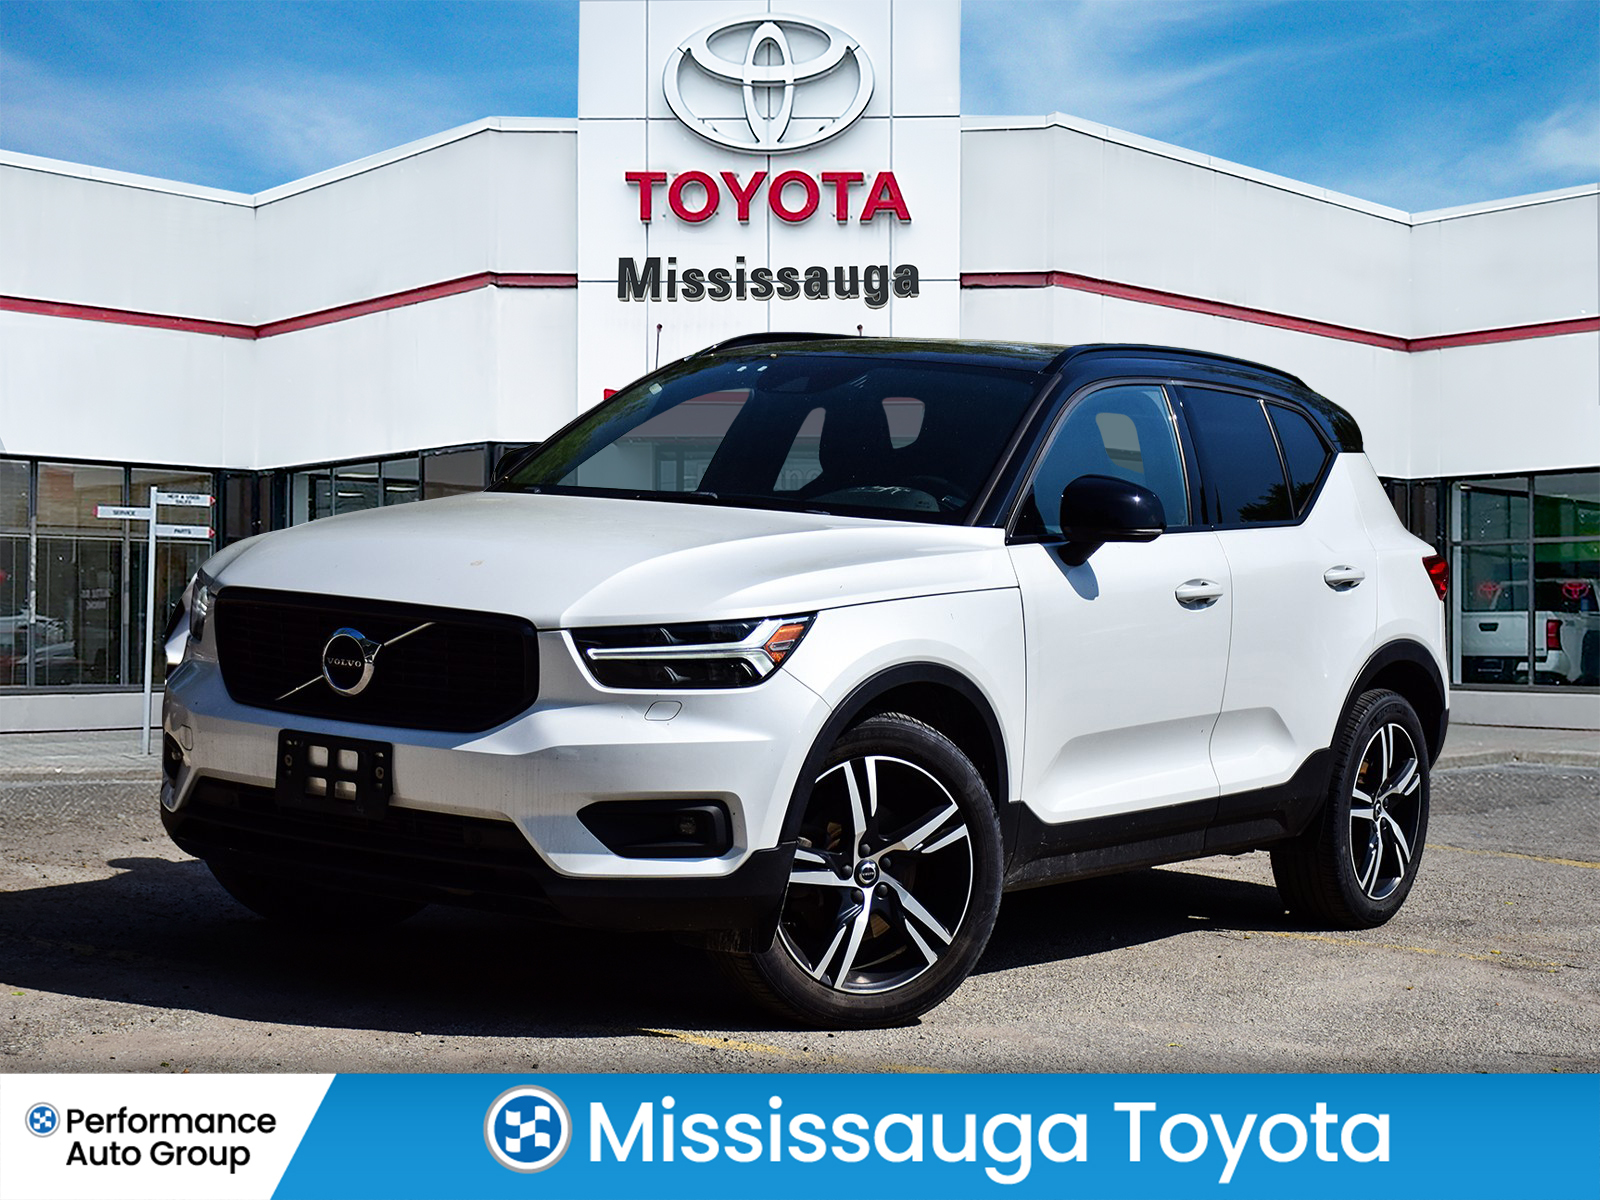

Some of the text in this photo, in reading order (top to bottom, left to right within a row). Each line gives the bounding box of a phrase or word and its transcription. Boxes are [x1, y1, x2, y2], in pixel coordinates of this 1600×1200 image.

[625, 170, 912, 224] TOYOTA
[617, 256, 920, 309] Mississauga
[327, 657, 362, 668] VOLVO
